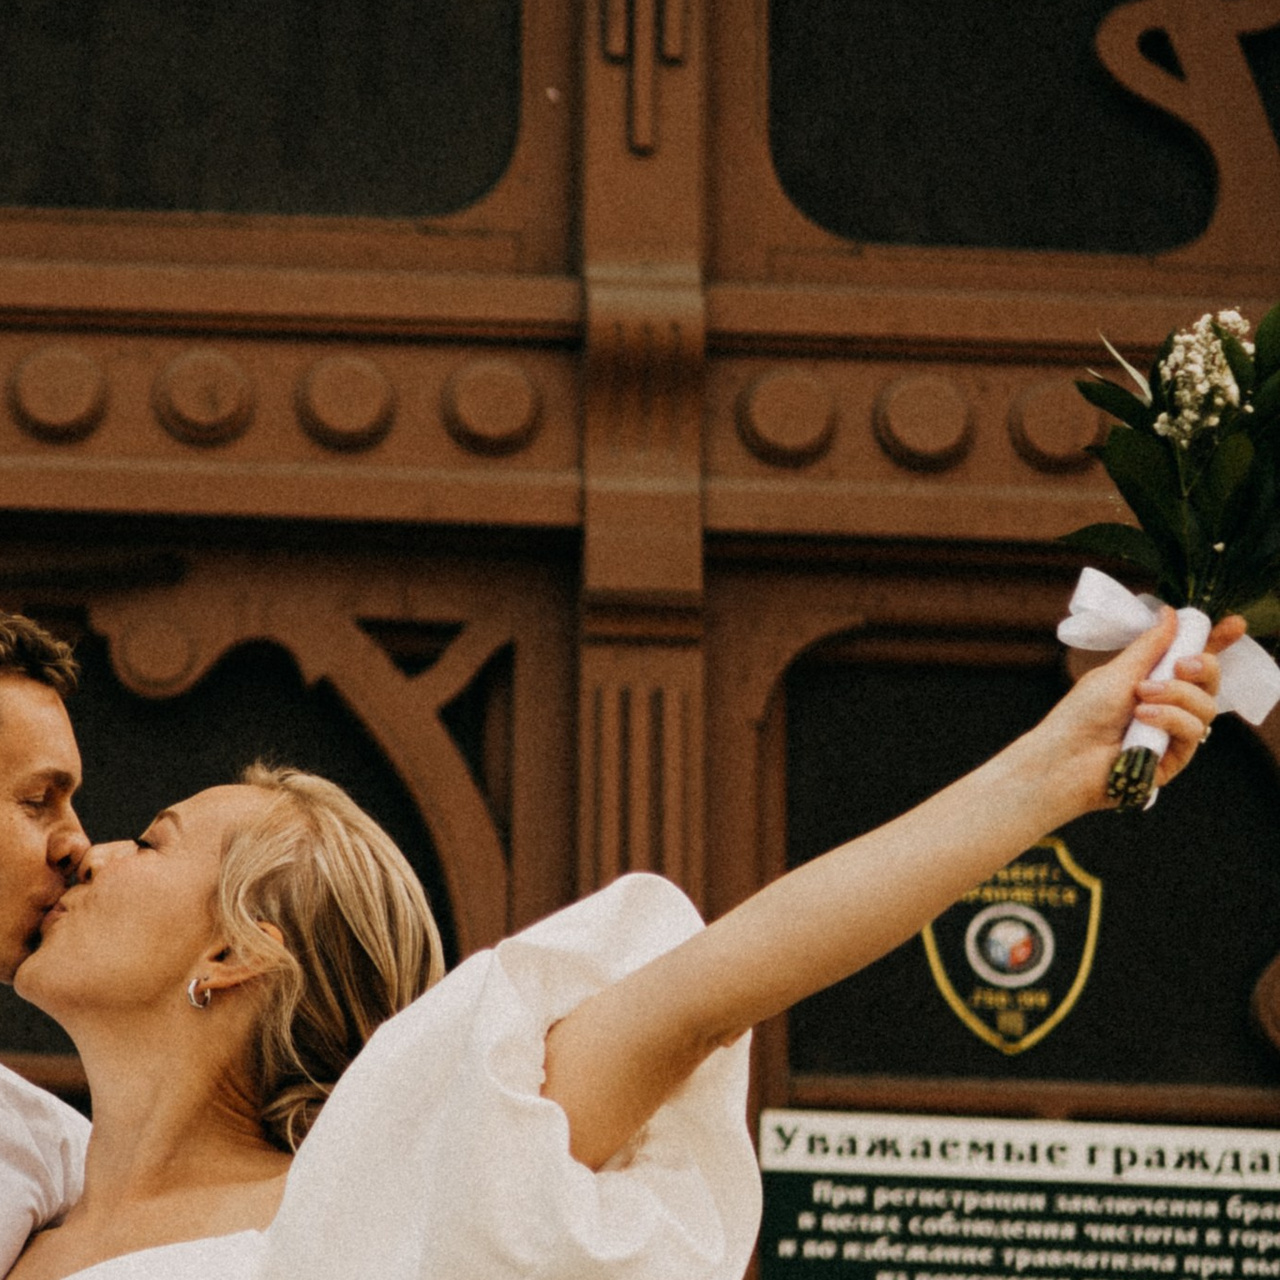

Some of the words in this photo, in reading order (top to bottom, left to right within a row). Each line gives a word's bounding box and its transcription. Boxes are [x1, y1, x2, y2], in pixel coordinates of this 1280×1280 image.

[775, 1124, 1068, 1167] Уважаемые
[1087, 1141, 1280, 1178] гражда
[1225, 1194, 1280, 1225] бра
